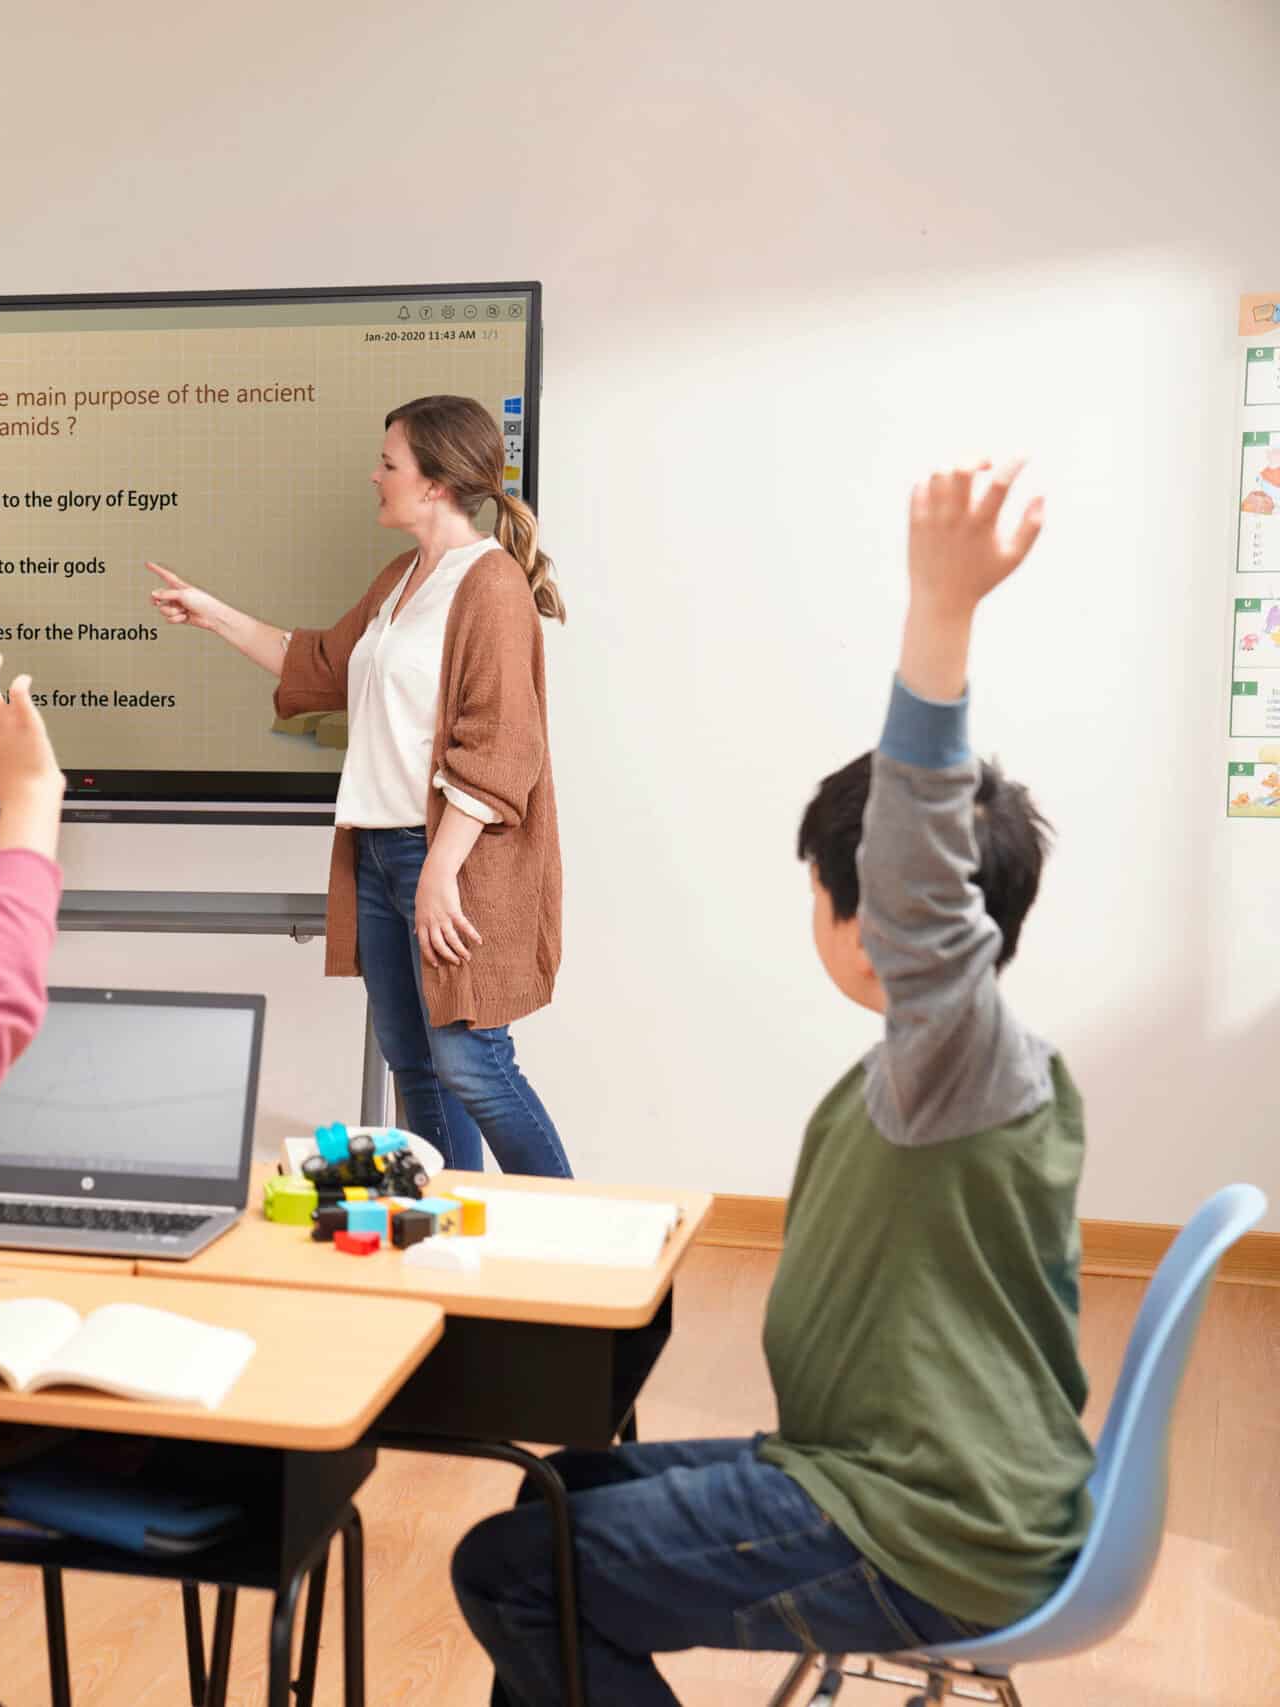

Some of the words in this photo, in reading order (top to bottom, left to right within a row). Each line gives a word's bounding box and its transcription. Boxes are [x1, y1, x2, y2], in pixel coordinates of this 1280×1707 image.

[364, 331, 425, 342] Jan-20-2020
[429, 330, 456, 341] 11:43
[458, 330, 476, 340] AM
[16, 386, 67, 407] main
[75, 389, 160, 411] purpose
[167, 384, 190, 405] of
[195, 384, 230, 404] the
[236, 382, 316, 404] ancient
[67, 416, 77, 436] ?
[2, 492, 20, 508] to
[24, 490, 53, 508] the
[57, 490, 102, 512] glory
[106, 489, 124, 507] of
[128, 490, 179, 512] Egypt
[19, 557, 60, 575] their
[64, 556, 106, 578] gods
[16, 623, 41, 641] for
[45, 623, 74, 641] the
[78, 623, 159, 641] Pharaohs
[52, 690, 75, 707] for
[80, 690, 108, 707] the
[113, 690, 176, 708] leaders
